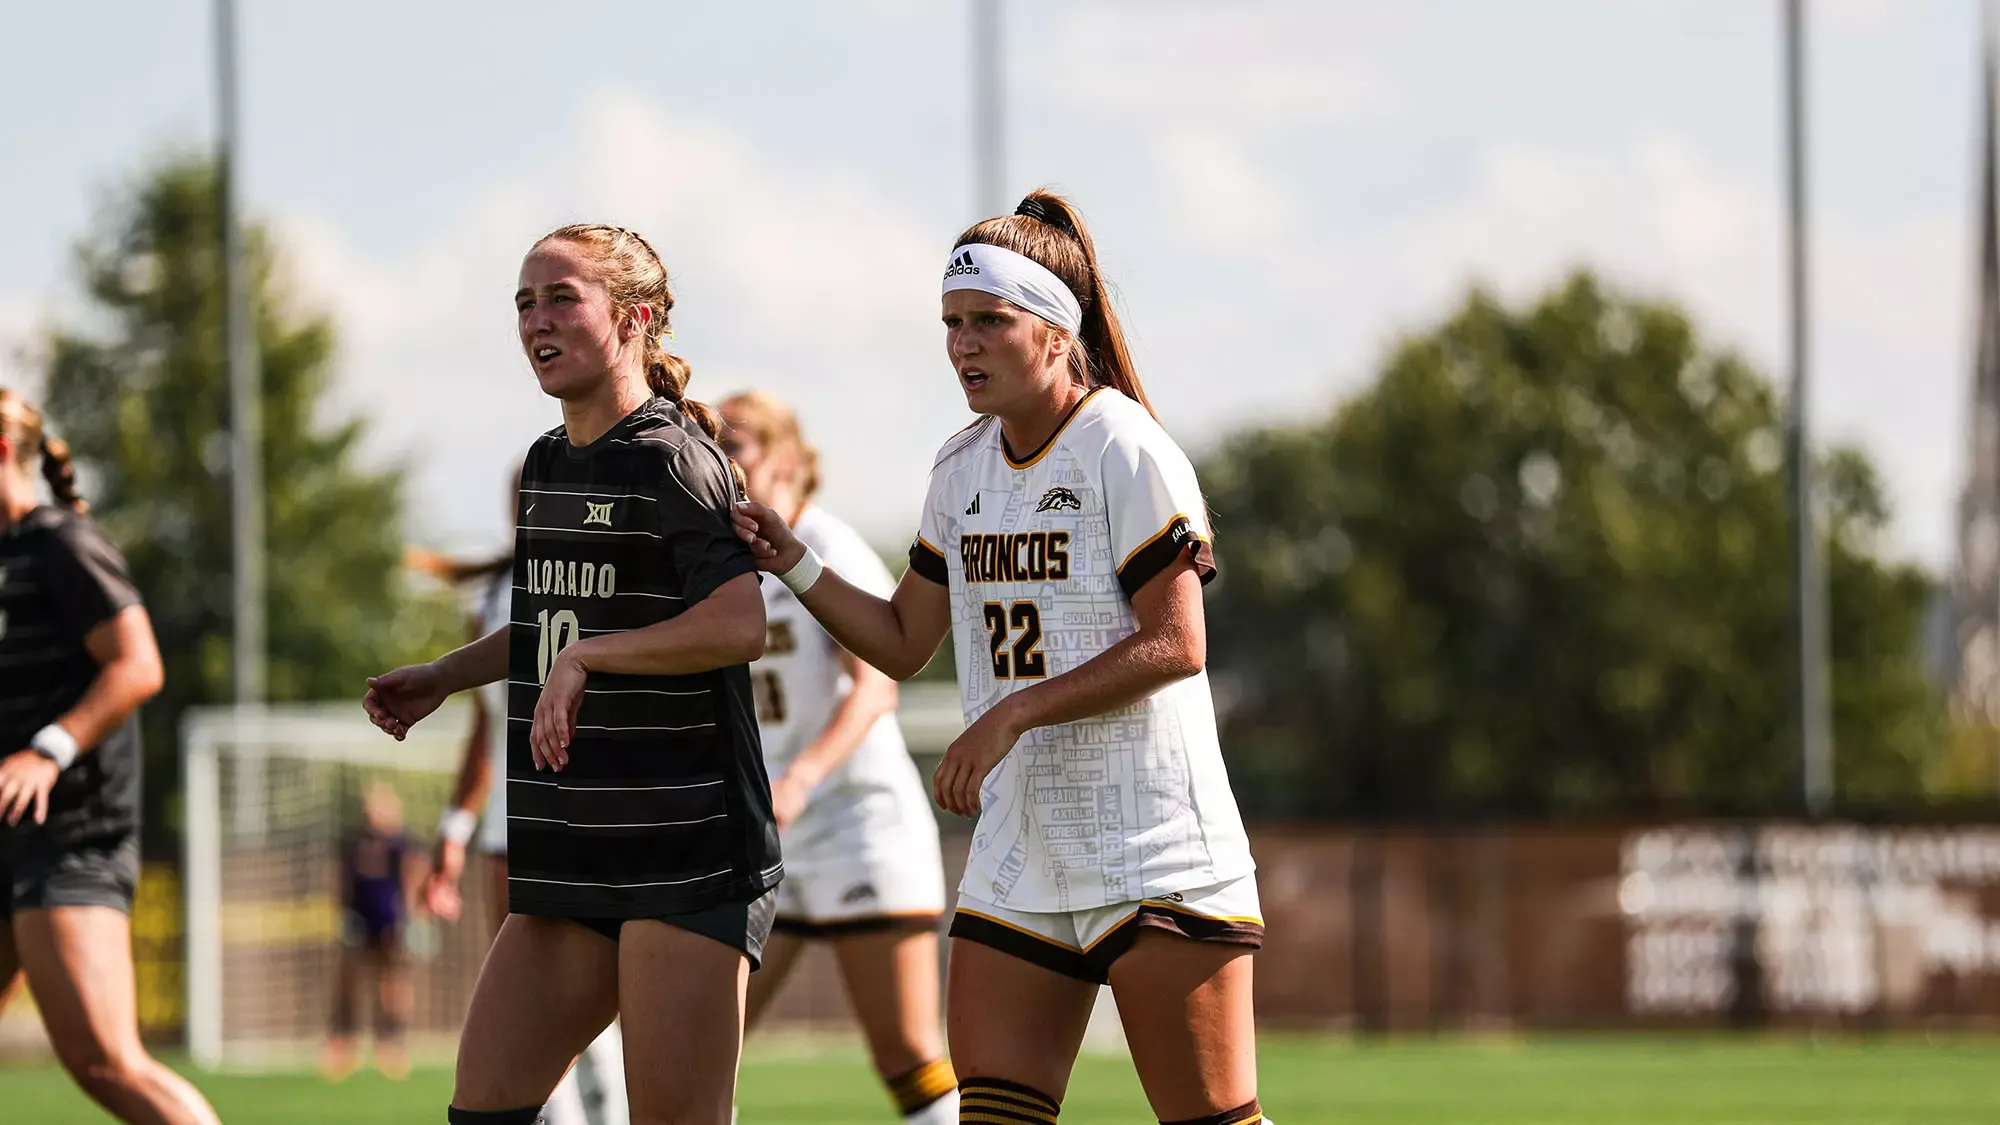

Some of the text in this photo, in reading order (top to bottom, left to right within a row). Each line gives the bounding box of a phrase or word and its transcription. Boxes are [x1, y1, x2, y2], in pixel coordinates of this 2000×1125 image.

[943, 264, 980, 280] adidas
[582, 501, 614, 527] XII
[960, 531, 1070, 583] BRONCOS
[1064, 613, 1100, 624] SOUTH
[983, 600, 1047, 680] 22
[1074, 723, 1144, 743] VINE ST
[1103, 787, 1117, 810] AVE
[1054, 809, 1084, 819] AXTELL
[1043, 826, 1082, 838] FOREST
